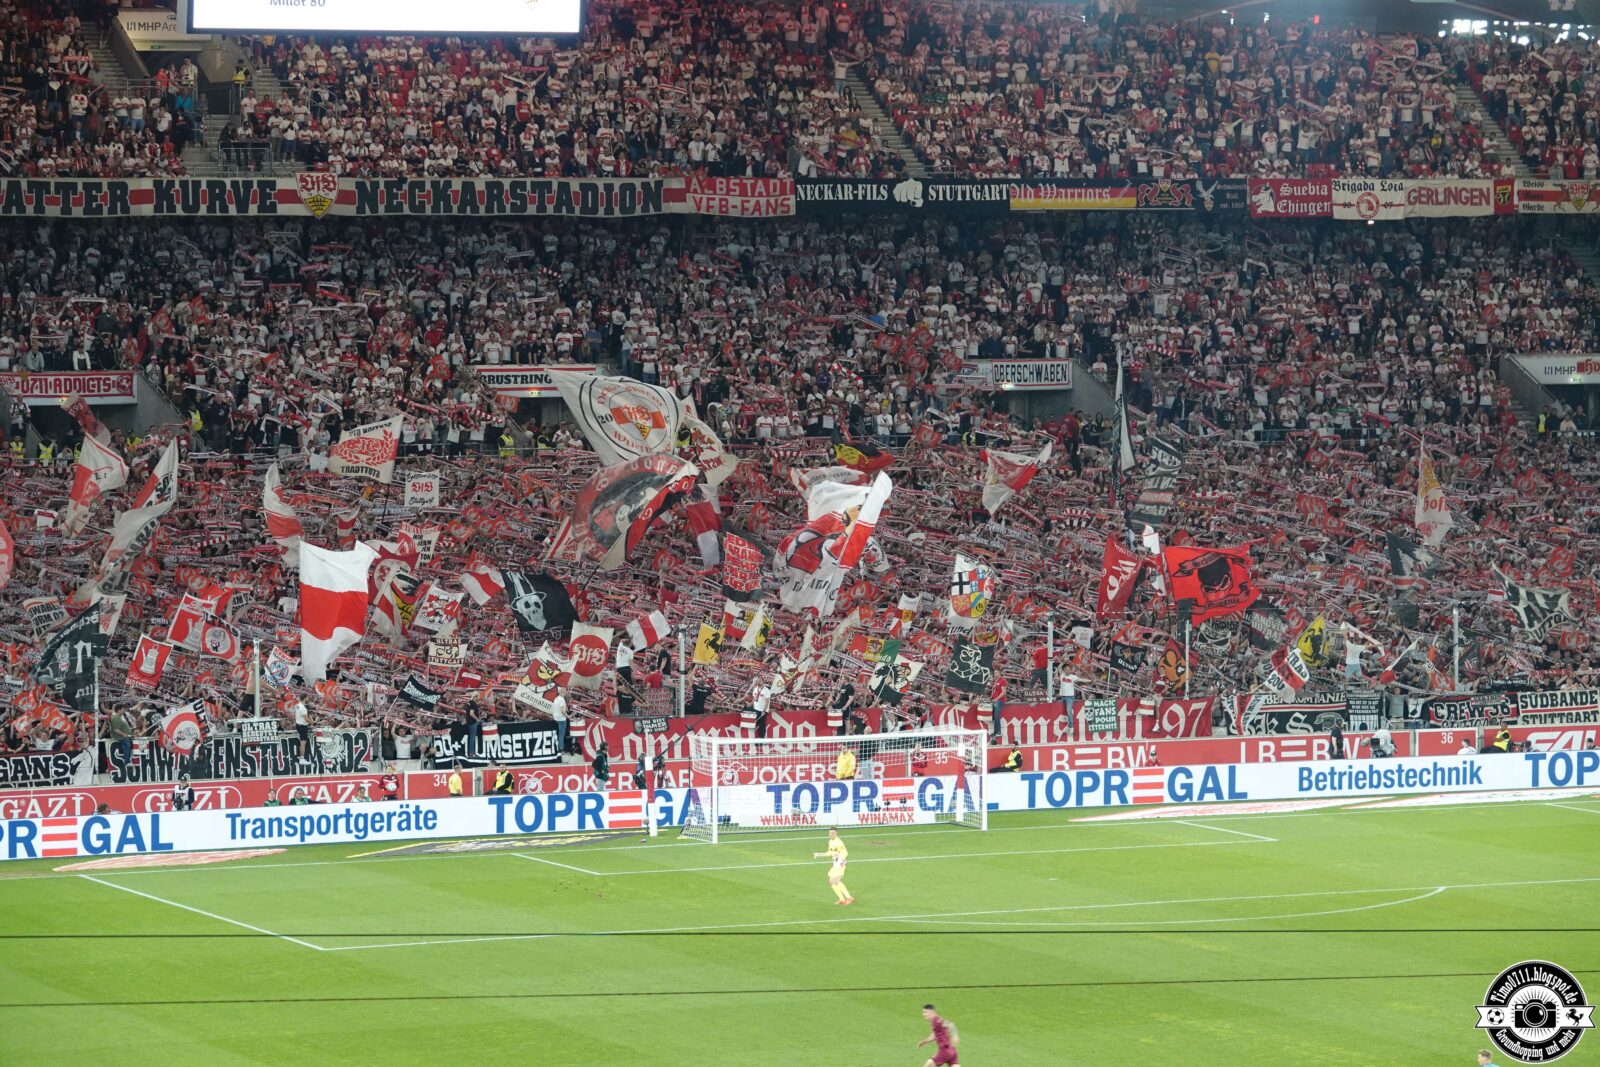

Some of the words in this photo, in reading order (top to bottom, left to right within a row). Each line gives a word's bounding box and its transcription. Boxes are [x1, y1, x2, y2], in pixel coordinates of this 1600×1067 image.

[797, 184, 888, 201] NECKAR-FILS
[928, 183, 1009, 201] STUTTGART
[1037, 182, 1111, 204] Warriors
[1280, 182, 1328, 196] Suebia
[1332, 180, 1375, 193] Brigada
[1380, 180, 1404, 192] Loca
[154, 180, 278, 214] KURVE
[356, 179, 664, 215] NECKARSTADION
[693, 195, 791, 214] VFB-FANS
[1407, 186, 1490, 206] GERLINGEN
[994, 364, 1067, 382] OBERSCHWABEN
[54, 377, 111, 394] ADDICTS
[598, 413, 613, 424] 20
[852, 649, 892, 662] Commando
[1520, 690, 1599, 709] SÜDBANDE
[1094, 707, 1116, 717] FANS
[1162, 701, 1207, 737] 97
[1433, 701, 1485, 721] CREW
[1522, 711, 1599, 724] STUTTGART
[241, 721, 277, 732] ULTRAS
[1441, 731, 1454, 744] 36
[935, 752, 949, 765] 35
[433, 774, 447, 787] 34
[555, 769, 694, 794] JOKERAR
[1298, 759, 1482, 792] Betriebstechnik
[1021, 765, 1248, 810] TOPREGAL
[144, 785, 226, 813] GZI
[488, 786, 730, 834] TOPREGA
[858, 812, 915, 825] WINAMAX
[226, 804, 438, 841] Transportgeräte
[760, 814, 817, 827] WINAMAX
[0, 813, 174, 859] REGAL
